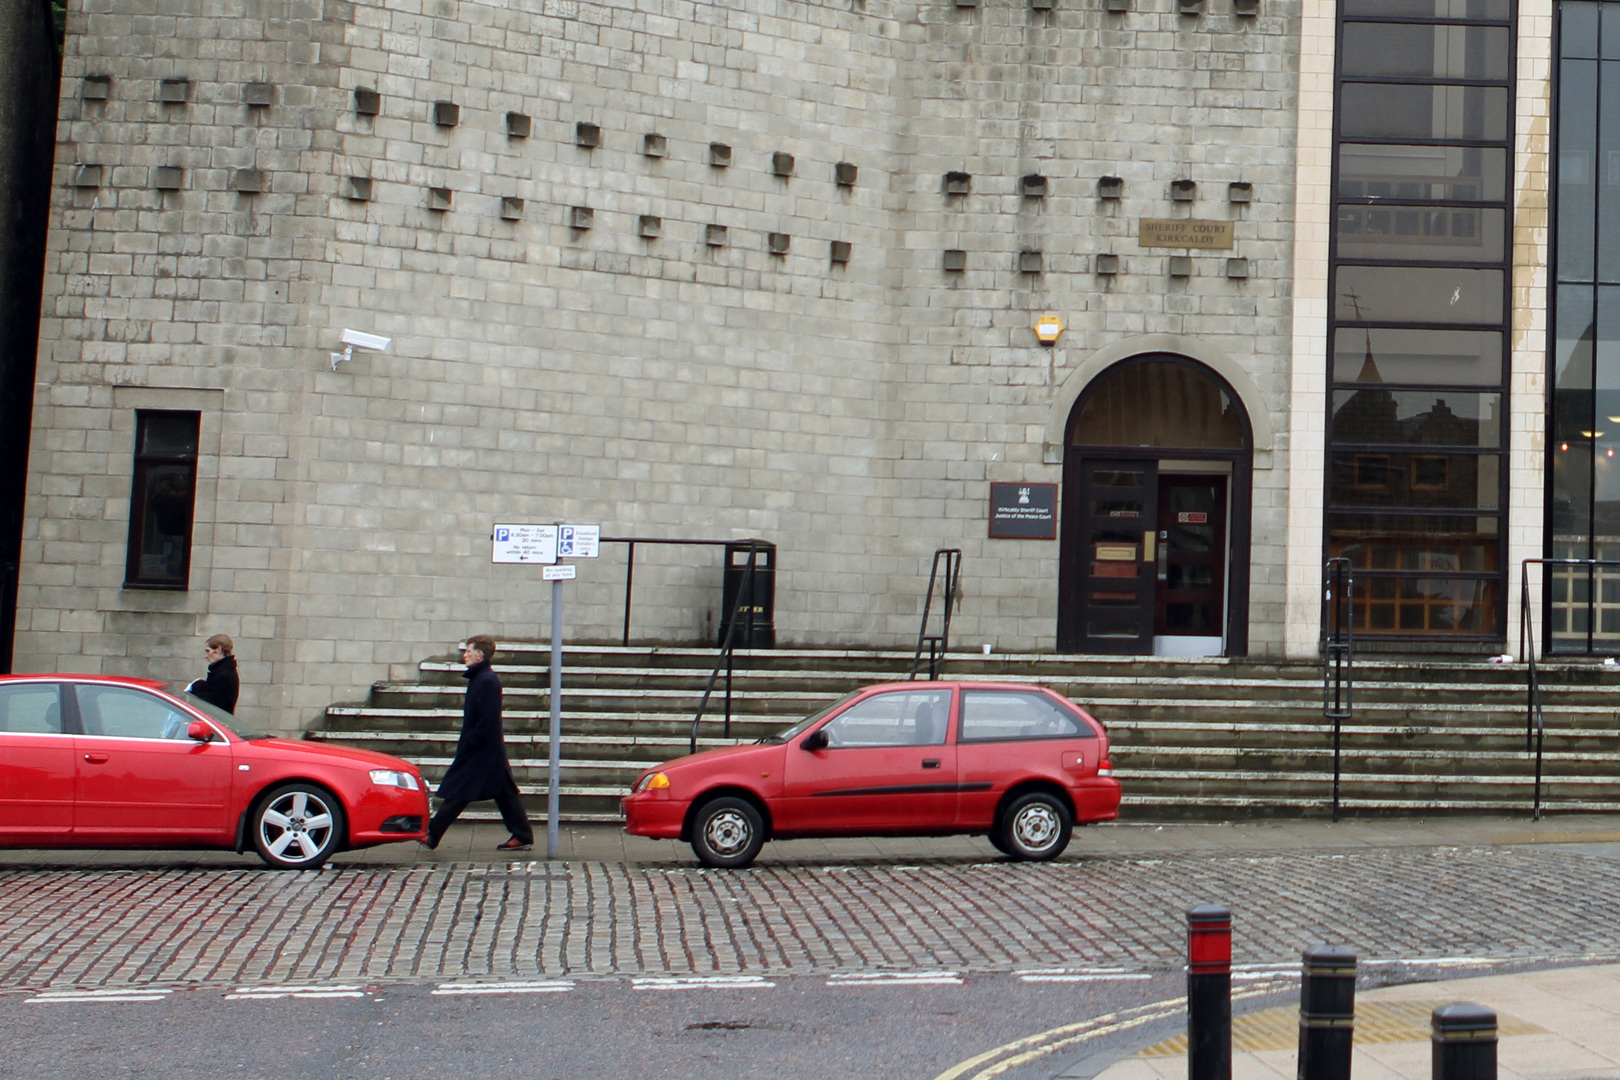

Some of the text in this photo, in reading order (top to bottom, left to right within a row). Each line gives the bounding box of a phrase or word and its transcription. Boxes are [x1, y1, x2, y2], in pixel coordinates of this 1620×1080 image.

[1146, 222, 1226, 233] SHERIFF COURT
[1156, 234, 1215, 244] KIRKCALDY
